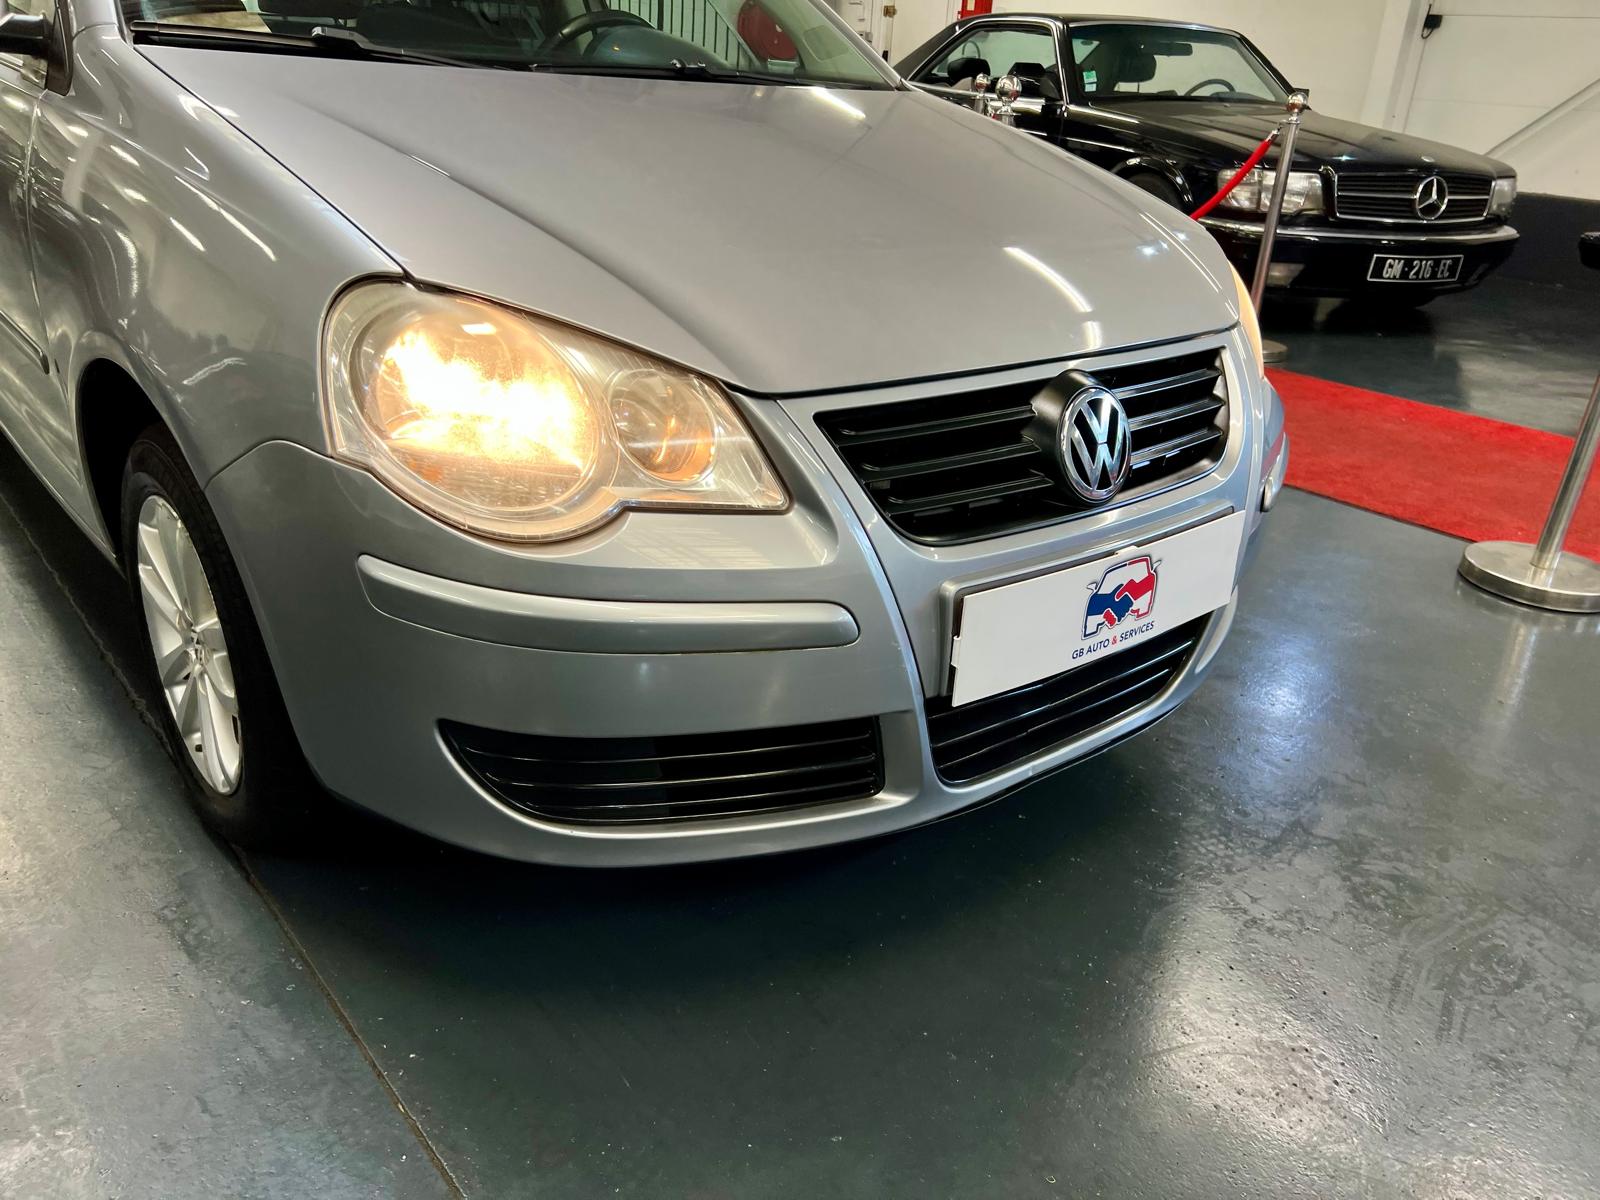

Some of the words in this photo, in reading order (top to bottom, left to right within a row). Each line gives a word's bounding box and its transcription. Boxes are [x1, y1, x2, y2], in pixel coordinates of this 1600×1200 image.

[1383, 259, 1404, 279] GM
[1409, 260, 1434, 279] 216
[1072, 648, 1084, 659] GB
[1086, 639, 1110, 654] AUTO
[1111, 635, 1118, 645] &
[1120, 621, 1154, 642] SERVICES
